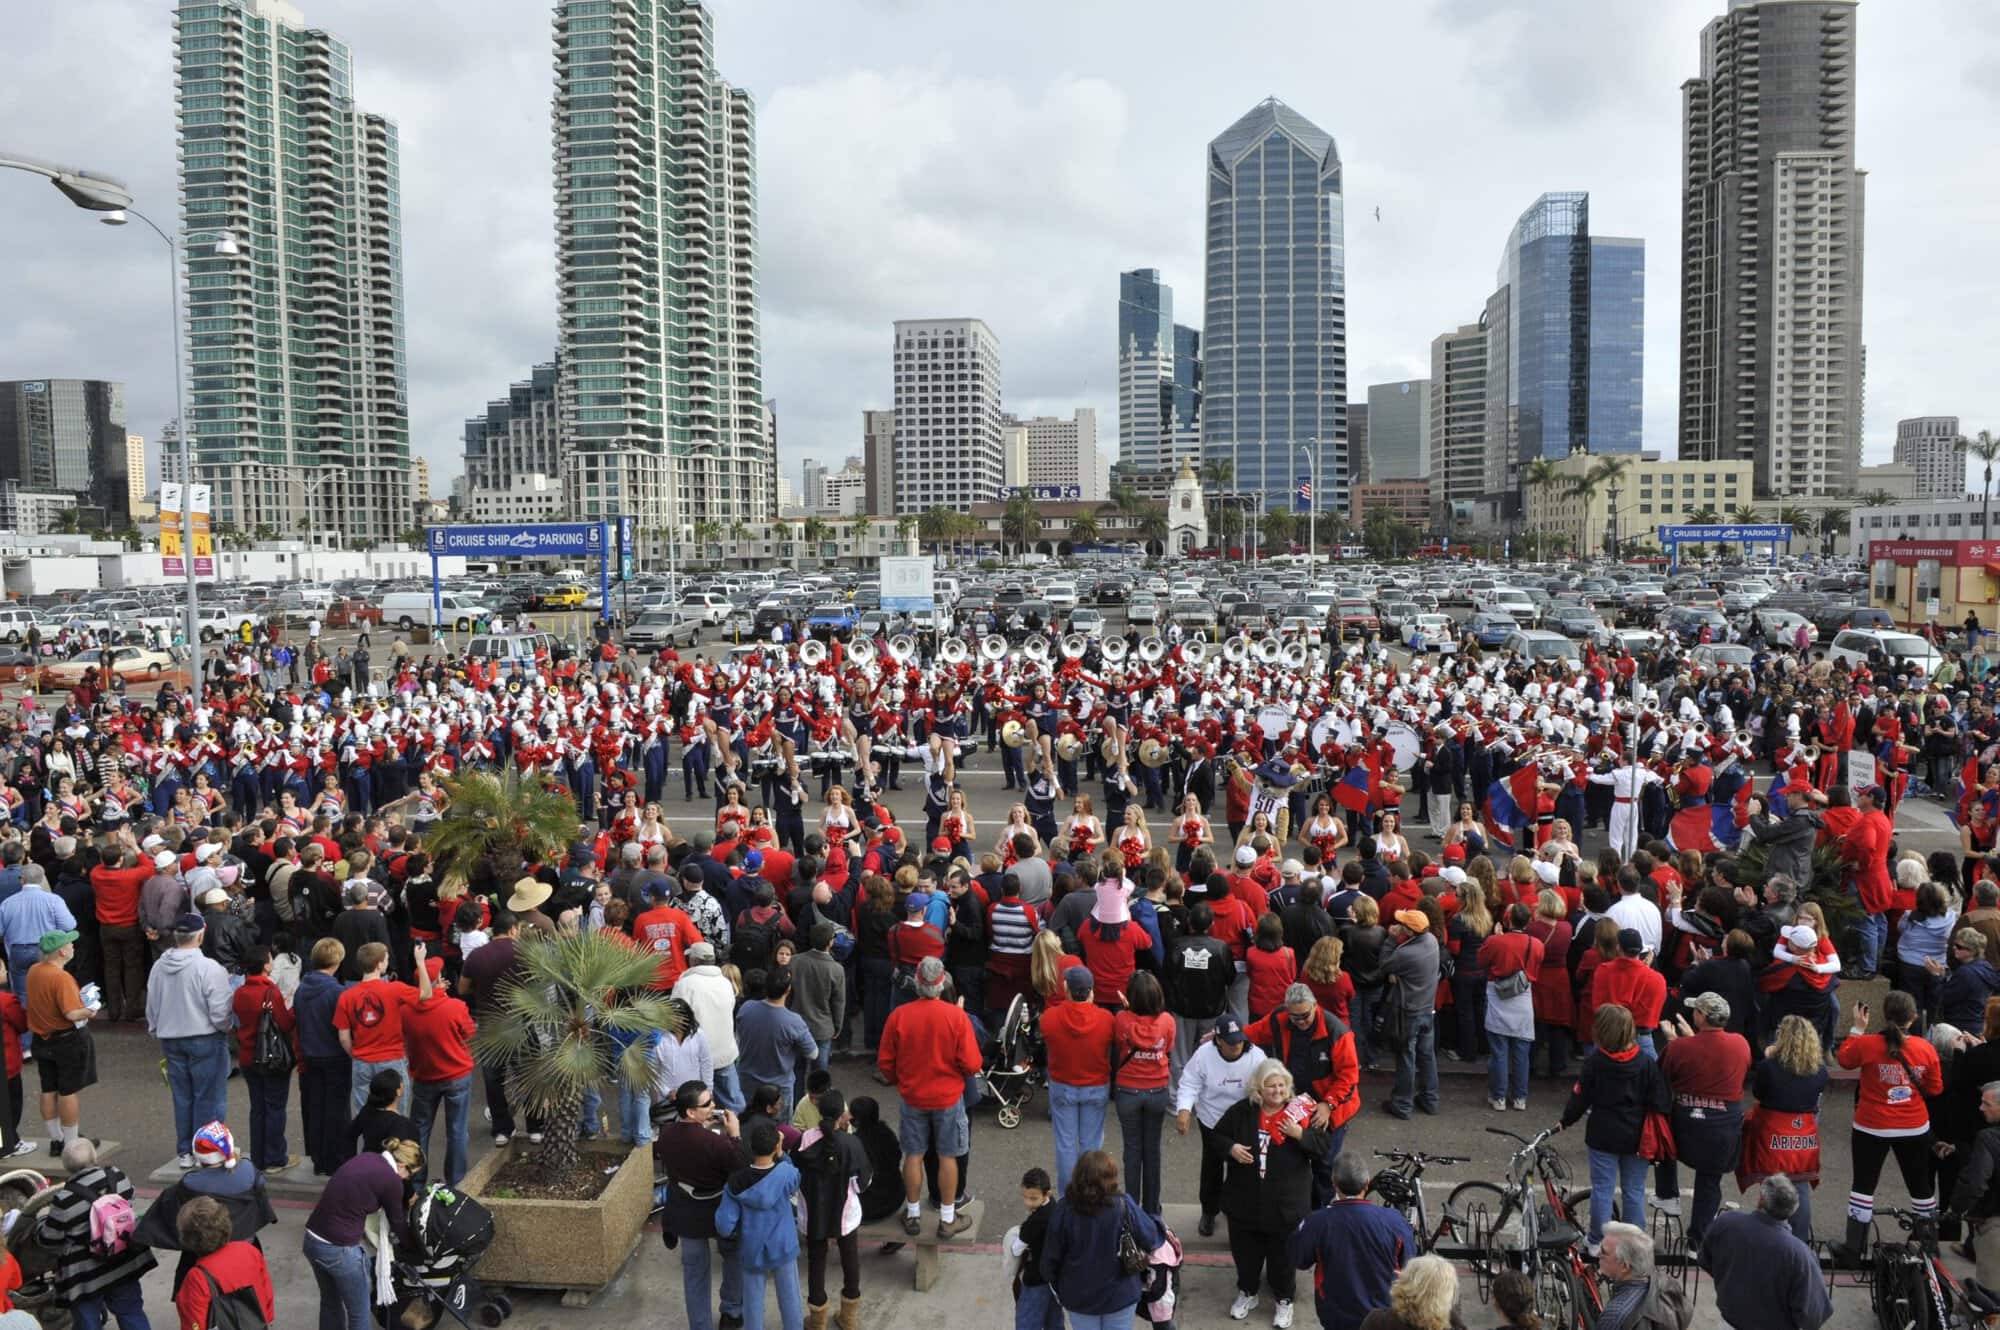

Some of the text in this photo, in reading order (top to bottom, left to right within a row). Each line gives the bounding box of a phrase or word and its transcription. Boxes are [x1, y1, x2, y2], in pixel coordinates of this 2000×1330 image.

[449, 534, 485, 547] CRUISE
[487, 533, 511, 546] SHIP
[539, 532, 584, 545] PARKING
[589, 528, 599, 542] 5
[1673, 530, 1701, 538] CRUISE
[1703, 530, 1721, 538] SHIP
[1914, 548, 1953, 556] INFORMATION
[624, 559, 631, 577] P
